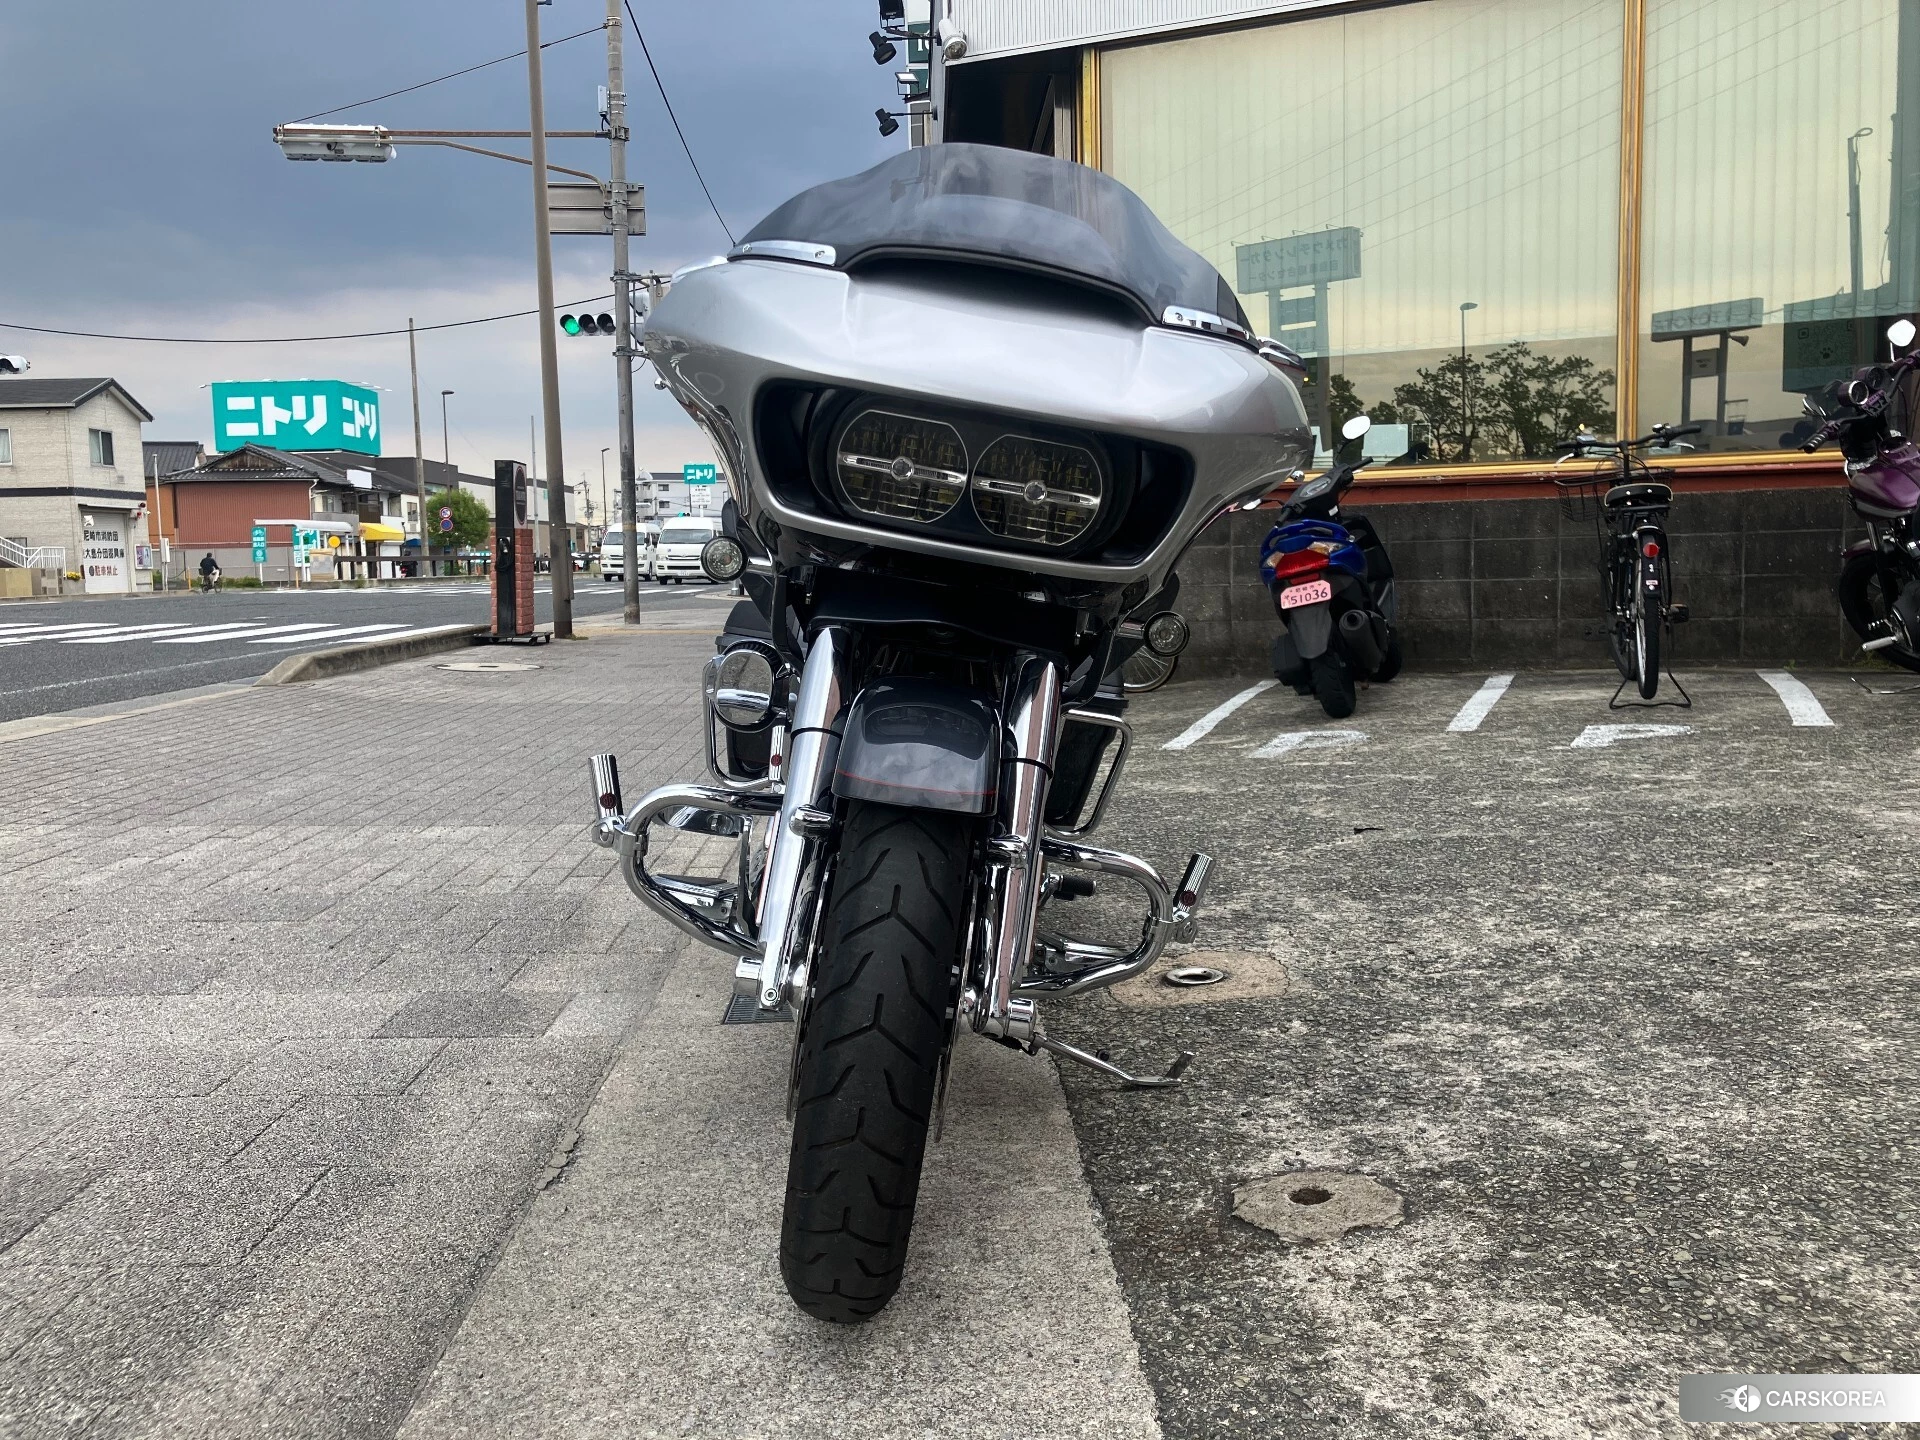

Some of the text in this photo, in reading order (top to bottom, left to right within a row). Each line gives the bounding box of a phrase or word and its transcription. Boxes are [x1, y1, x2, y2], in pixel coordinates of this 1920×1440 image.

[226, 395, 328, 436] ニトリ
[342, 396, 377, 442] ニトリ
[687, 468, 713, 480] ニトリ
[83, 530, 119, 541] 尼崎市消防団
[94, 565, 118, 577] 駐車禁止
[1291, 587, 1328, 605] 51036
